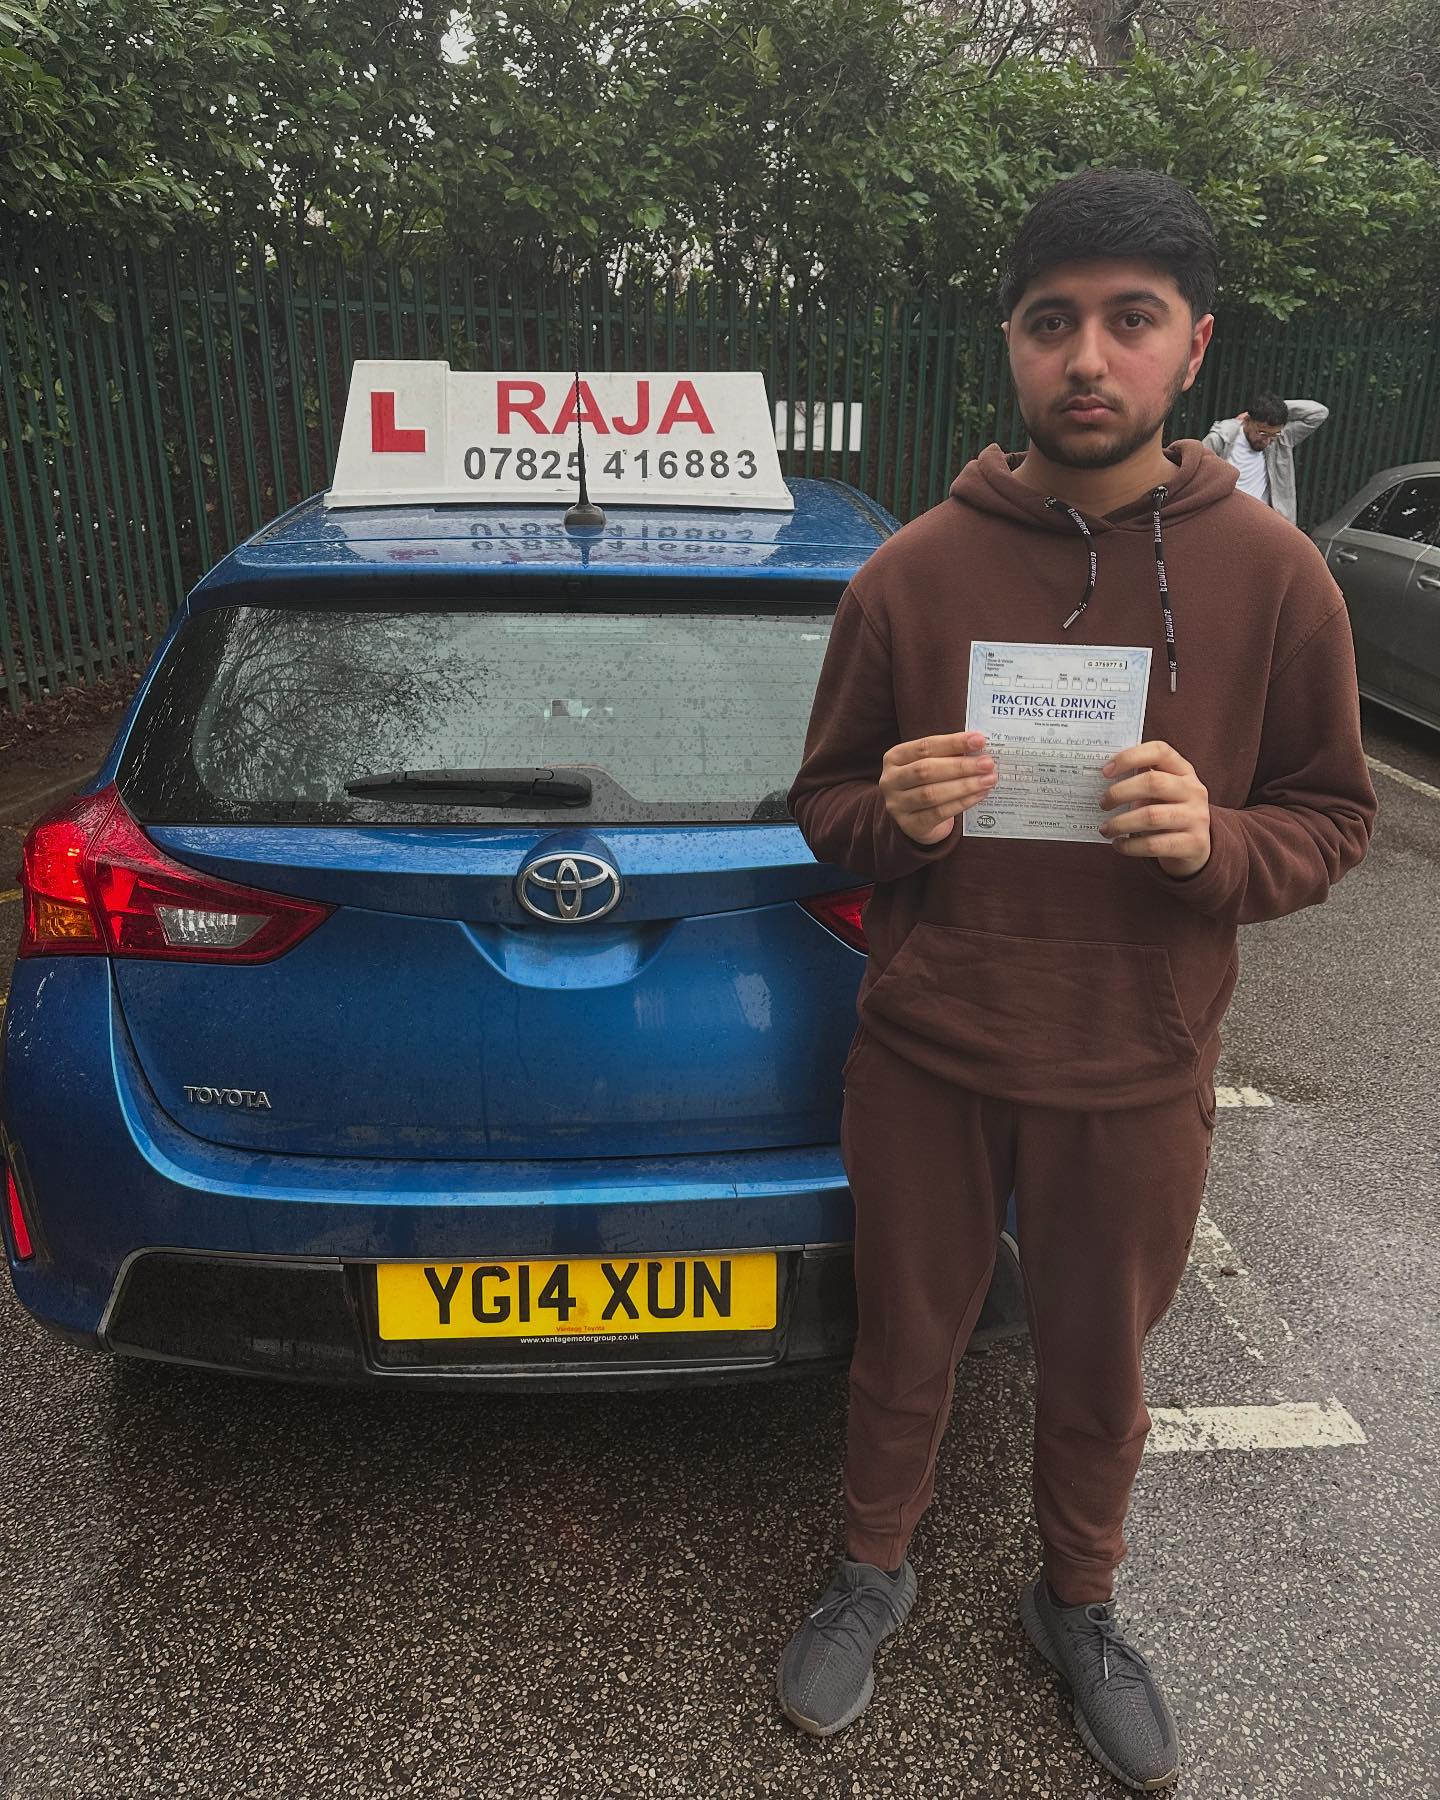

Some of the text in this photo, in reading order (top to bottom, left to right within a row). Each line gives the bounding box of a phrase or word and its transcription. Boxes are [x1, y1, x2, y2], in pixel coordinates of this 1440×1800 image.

[370, 391, 426, 453] L
[497, 380, 715, 435] RAJA
[464, 446, 758, 482] 07825 416883
[992, 694, 1116, 709] PRACTICAL DRIVING
[992, 706, 1115, 720] TEST PASS CERTIFICATE
[183, 1086, 272, 1108] TOYOTA
[424, 1260, 732, 1324] YG14 XUN
[520, 1334, 640, 1344] www.vantagemotorgroup.co.uk
